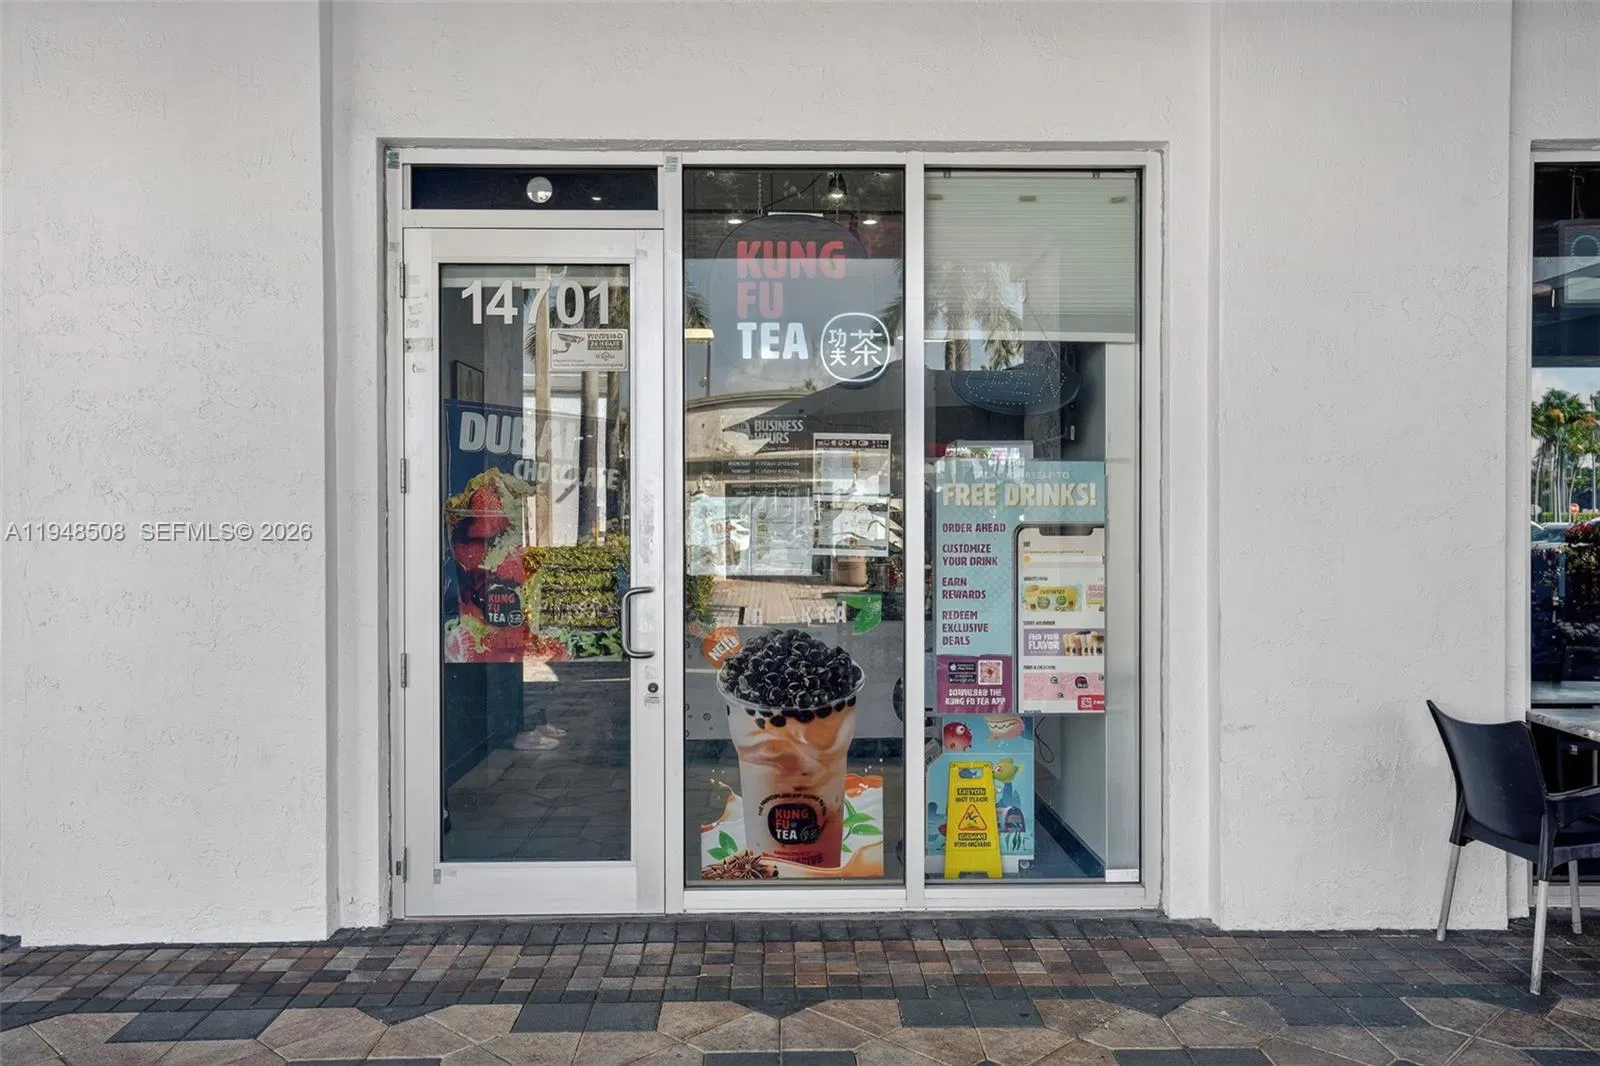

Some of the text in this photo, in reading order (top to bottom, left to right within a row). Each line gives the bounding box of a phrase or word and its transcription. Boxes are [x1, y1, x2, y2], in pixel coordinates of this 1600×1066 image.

[736, 240, 846, 279] KUNG
[461, 279, 610, 325] 14701
[736, 281, 784, 319] FU
[736, 322, 809, 360] TEA
[754, 419, 805, 432] BUSINESS
[754, 432, 790, 444] HOURS
[942, 483, 1098, 507] FREE DRINKS!
[942, 523, 1006, 533] ORDER AHEAD
[942, 543, 992, 554] CUSTOMIZE
[942, 556, 998, 566] YOUR DRINK
[942, 577, 967, 587] EARN
[488, 593, 516, 604] KUNG
[942, 590, 986, 599] REWARDS
[488, 612, 506, 623] TEA
[942, 611, 978, 620] REDEEM
[942, 623, 989, 633] EXCLUSIVE
[942, 636, 970, 646] DEALS
[1028, 640, 1060, 650] FLAVOR
[989, 688, 1002, 696] THE
[945, 697, 965, 705] KUNG
[976, 697, 990, 705] TEA
[991, 697, 1006, 705] APP
[775, 808, 809, 819] KUNG
[775, 818, 790, 829] FU
[775, 829, 798, 840] TEA
